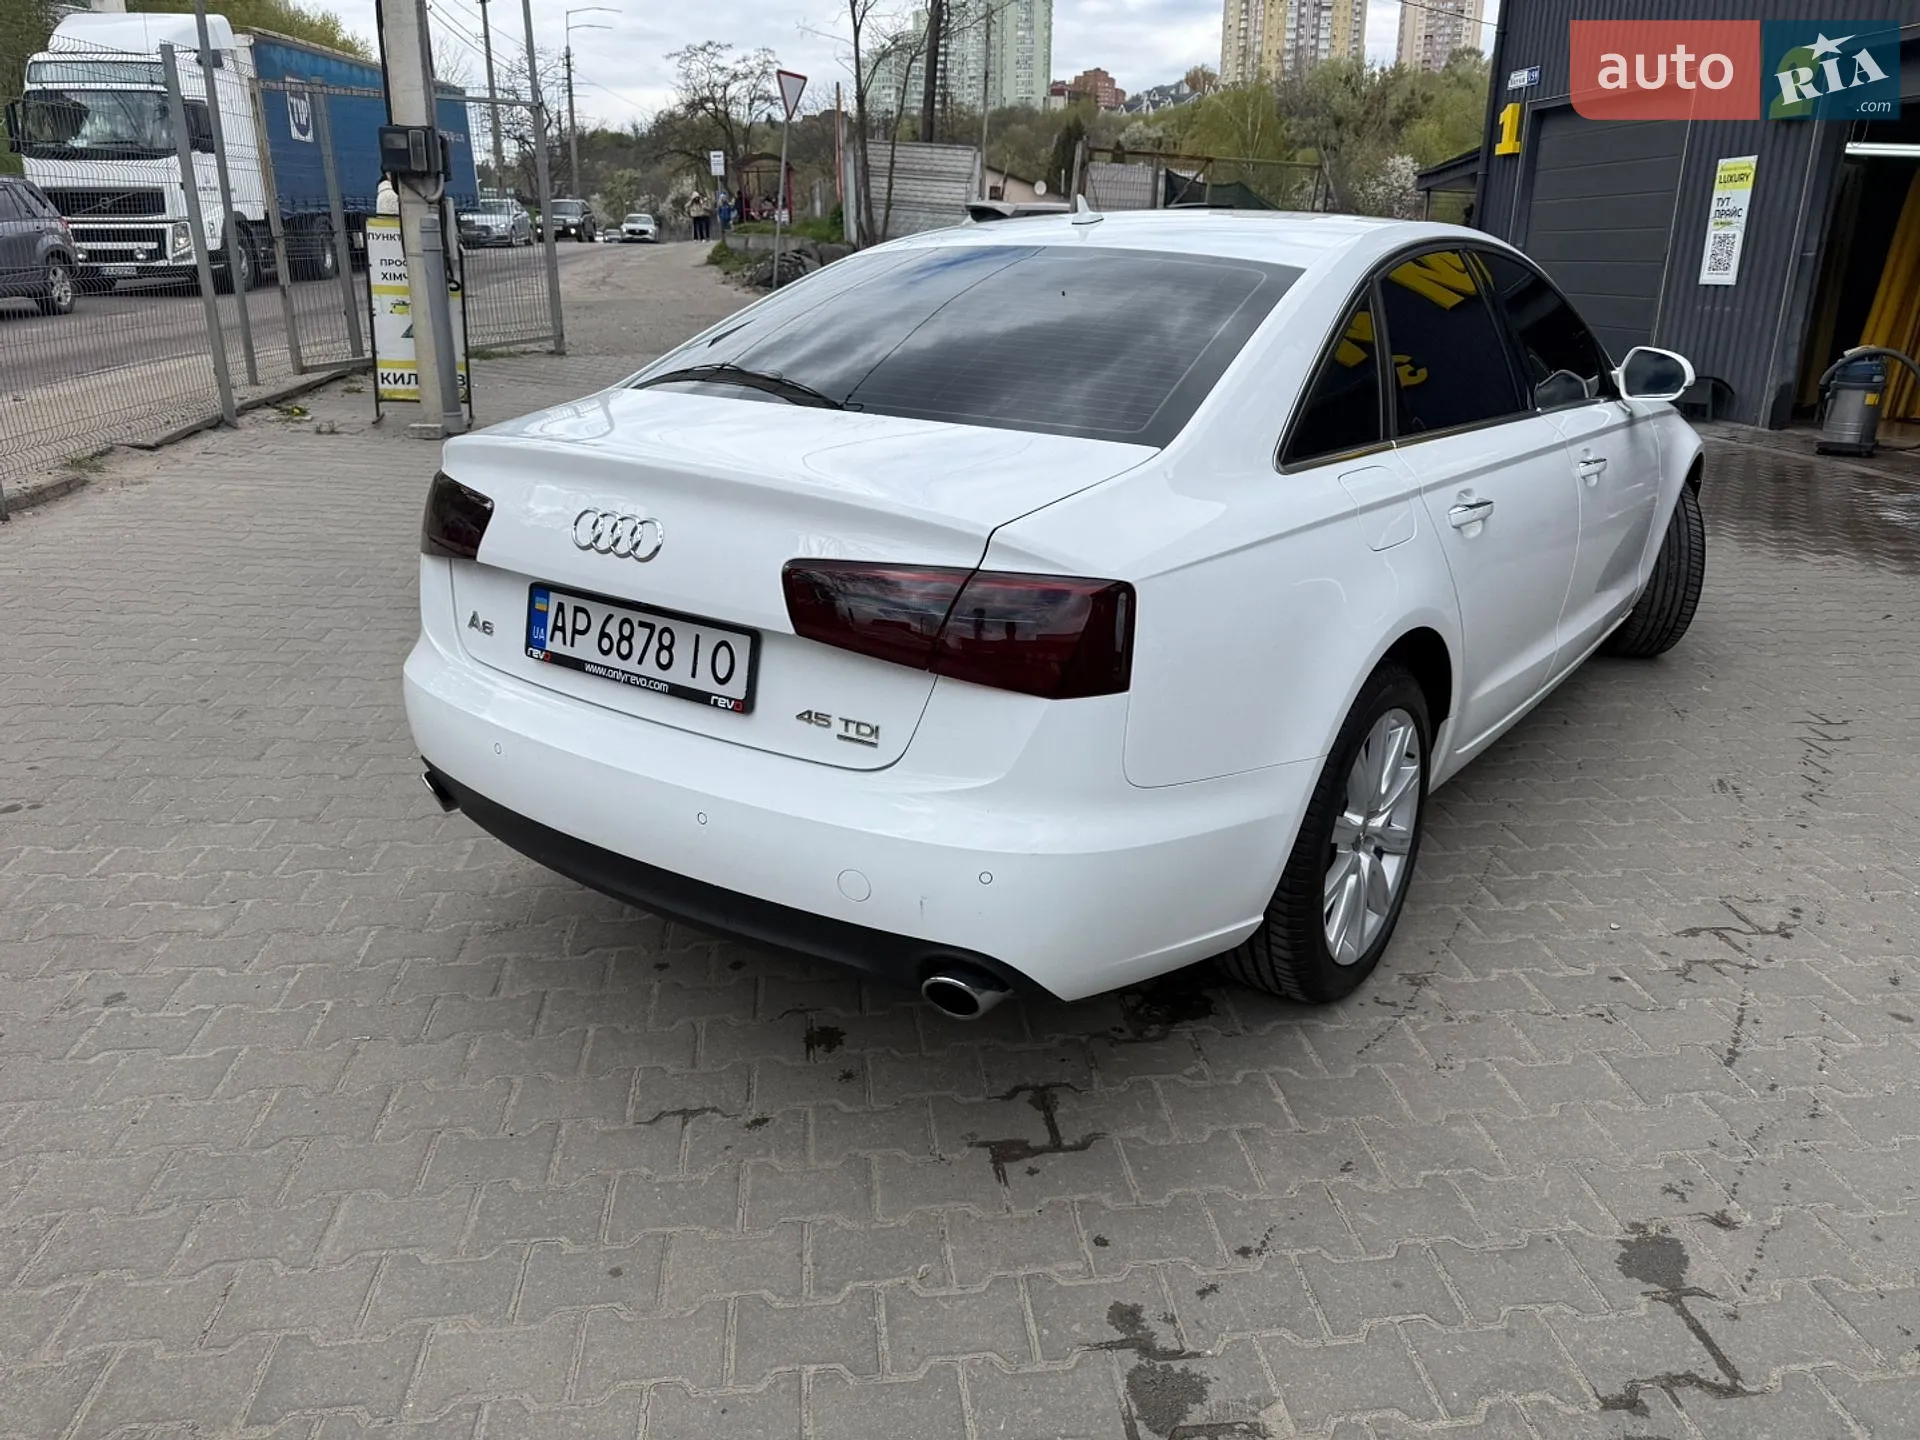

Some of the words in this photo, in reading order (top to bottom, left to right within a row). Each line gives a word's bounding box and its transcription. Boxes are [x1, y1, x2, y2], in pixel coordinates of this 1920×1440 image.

[1495, 103, 1521, 155] 1
[1719, 173, 1750, 184] LUXURY
[1714, 206, 1743, 218] ПРАЙС
[1716, 197, 1731, 207] ТУТ
[467, 610, 494, 637] A6
[533, 625, 545, 641] UA
[549, 601, 592, 648] AP
[597, 613, 676, 671] 6878
[584, 662, 670, 693] www.onlyrevo.com
[796, 709, 832, 729] 45
[838, 717, 880, 740] TDI
